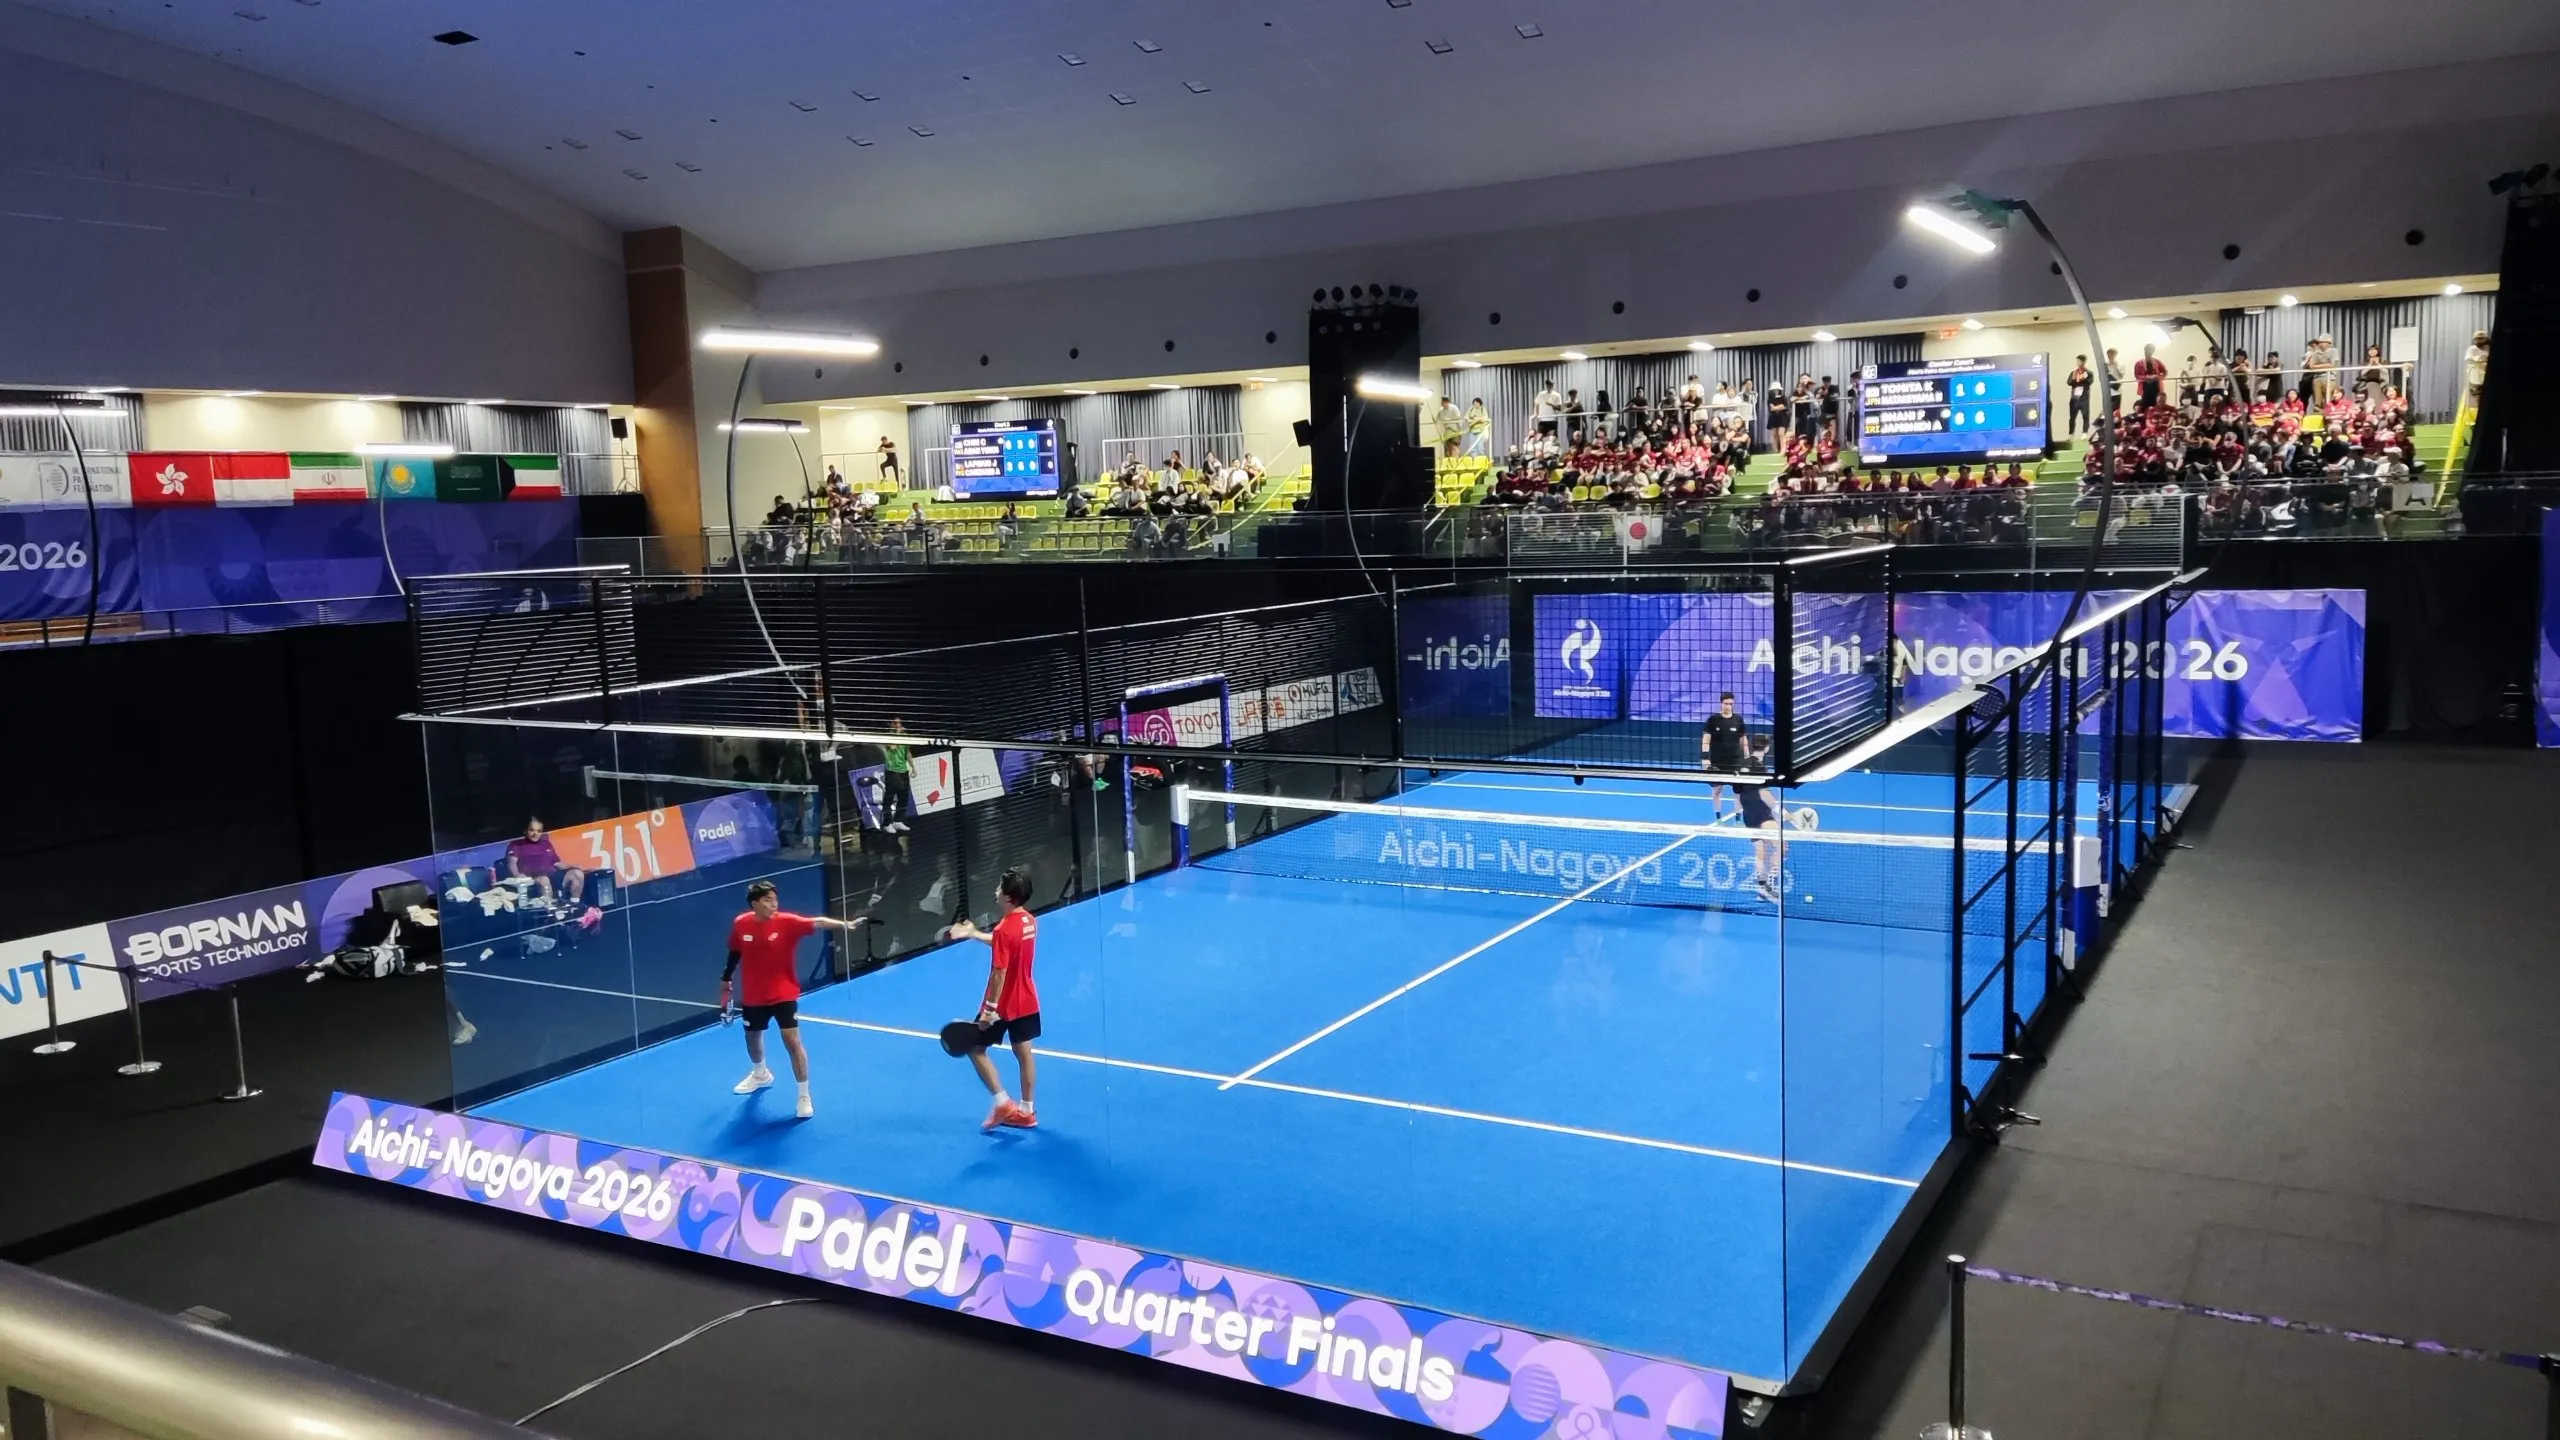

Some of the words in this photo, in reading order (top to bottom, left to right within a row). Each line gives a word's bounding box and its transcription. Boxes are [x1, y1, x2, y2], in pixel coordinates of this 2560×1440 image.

[1865, 396, 1881, 406] JPN
[1955, 383, 1965, 397] 1
[0, 541, 87, 571] 2026
[2110, 640, 2248, 681] 2026
[1302, 682, 1329, 698] MUFG
[1175, 711, 1221, 736] TOYOT
[699, 821, 736, 842] Padel
[1378, 828, 1662, 893] Aichi-Nagoya
[1679, 851, 1795, 893] 2026
[123, 901, 307, 965] BORNAN
[138, 956, 202, 983] SPORTS
[204, 930, 308, 967] TECHNOLOGY
[349, 1118, 573, 1207] Aichi-Nagoya
[583, 1165, 673, 1223] 2026
[781, 1197, 969, 1295] Padel
[1064, 1268, 1274, 1358] Quarter
[1286, 1317, 1456, 1402] Finals
